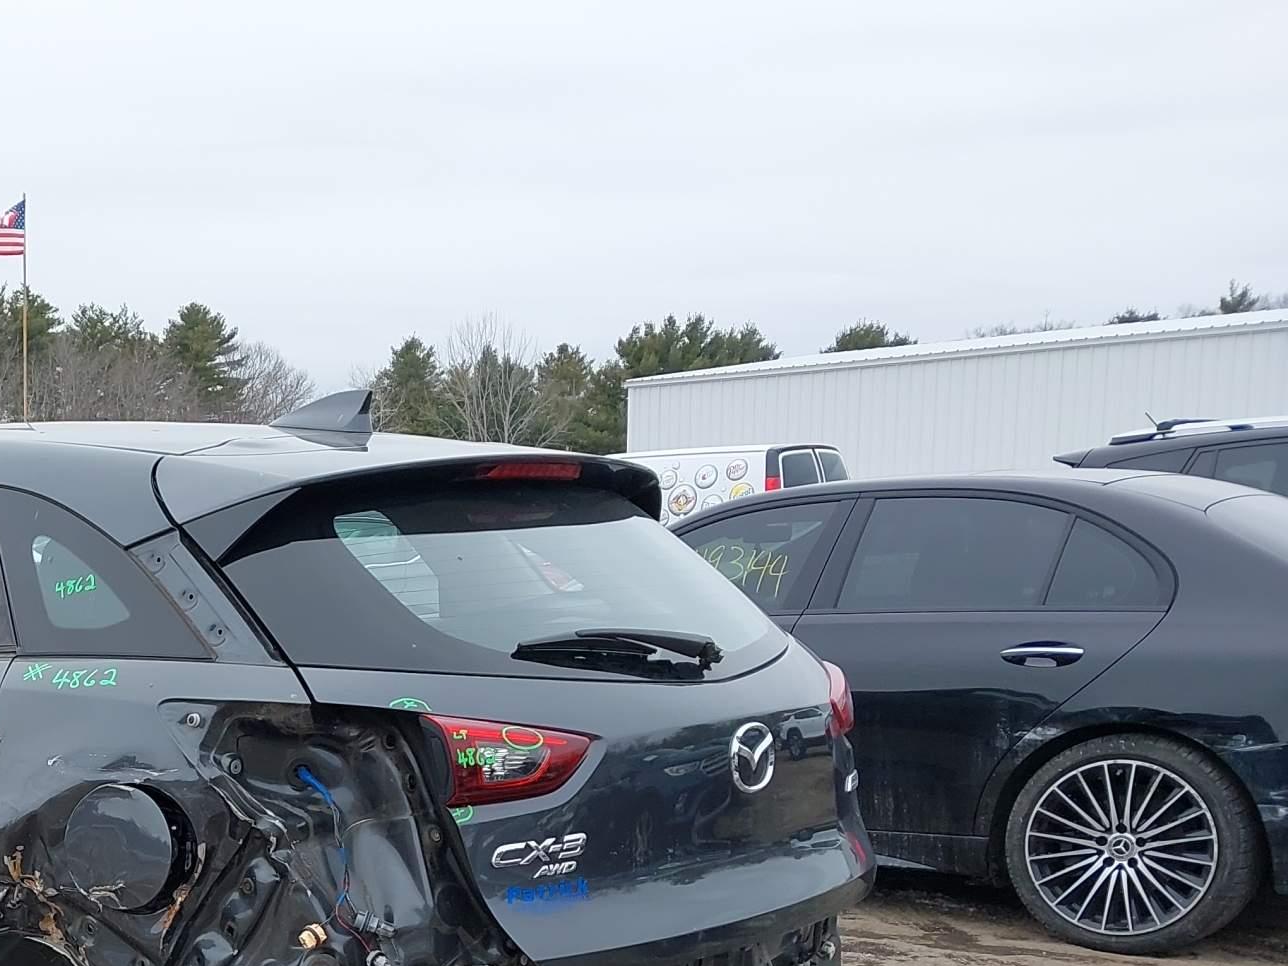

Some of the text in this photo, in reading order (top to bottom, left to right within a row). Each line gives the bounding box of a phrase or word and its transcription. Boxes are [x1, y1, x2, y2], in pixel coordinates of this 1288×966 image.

[695, 545, 791, 598] 93144
[55, 574, 97, 599] 4862
[52, 668, 117, 689] 4862
[491, 832, 588, 868] CX-3
[533, 860, 577, 879] AWD
